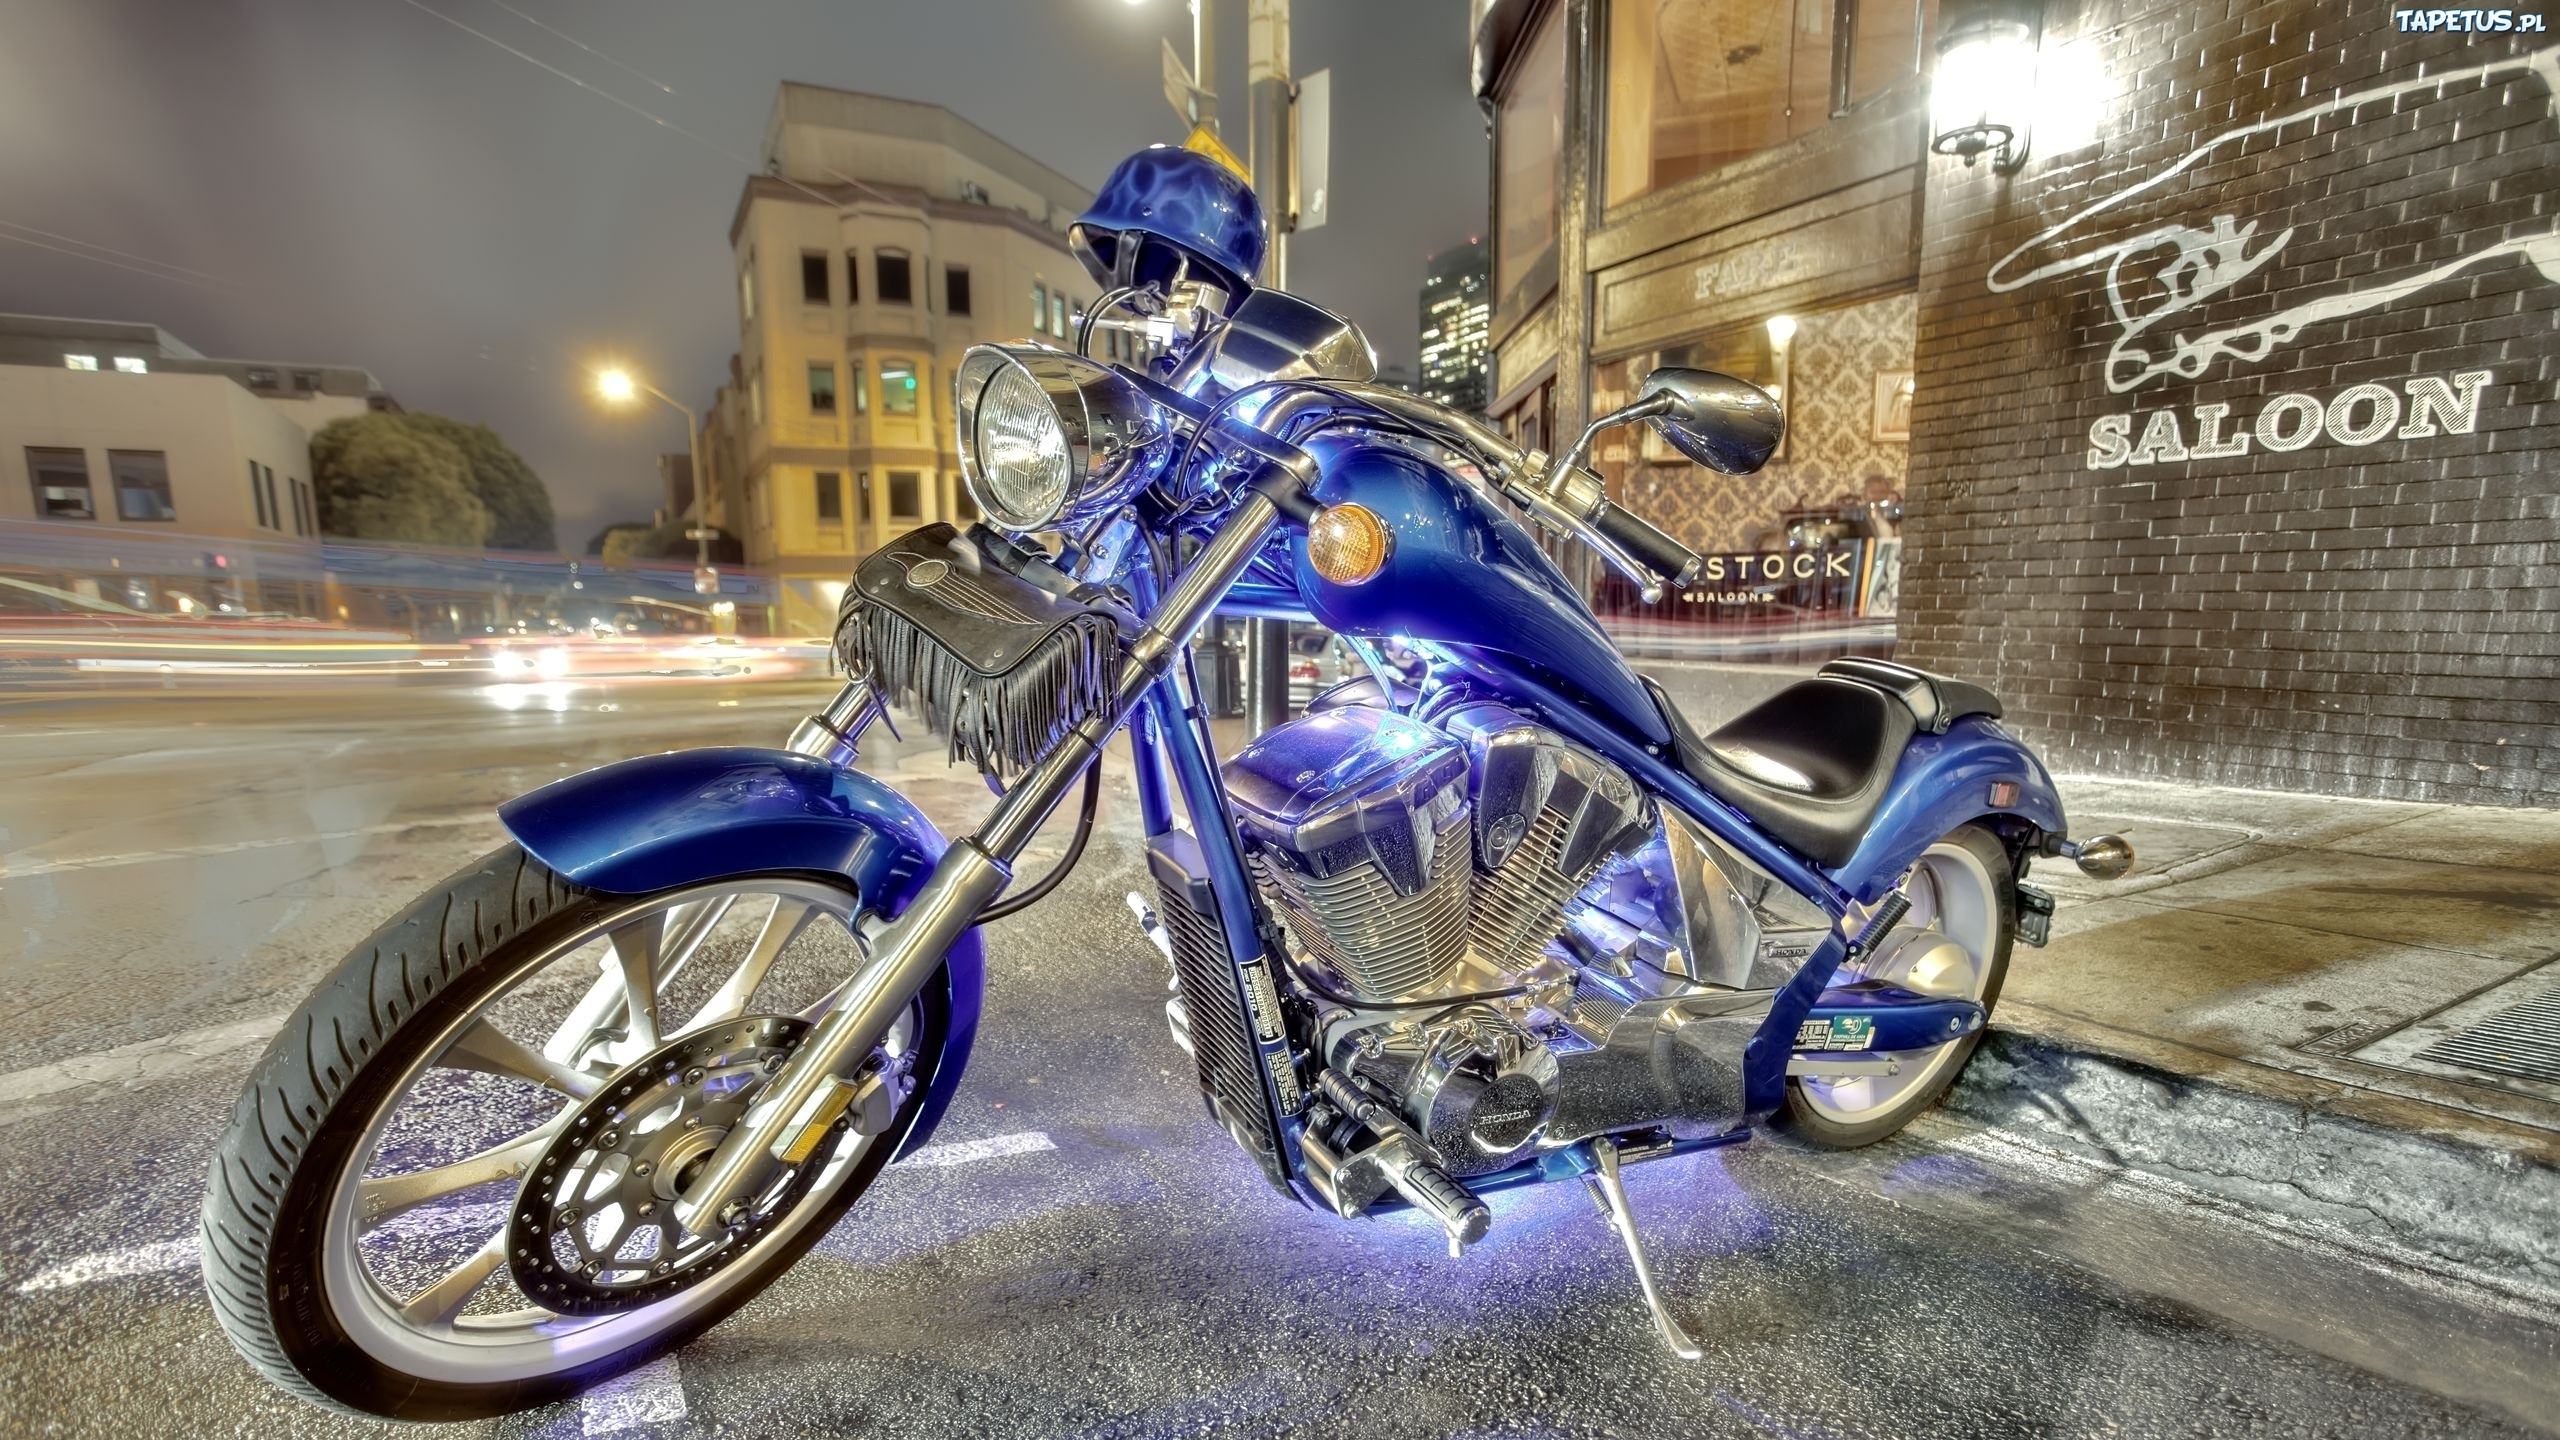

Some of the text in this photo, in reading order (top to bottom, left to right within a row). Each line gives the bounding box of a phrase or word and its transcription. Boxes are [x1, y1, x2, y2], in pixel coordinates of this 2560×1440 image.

[2087, 370, 2493, 470] SALOON
[1696, 592, 1758, 603] SALOON
[1775, 948, 1807, 956] HONDA
[1246, 984, 1258, 1011] 2010
[1480, 1109, 1531, 1125] HONDA
